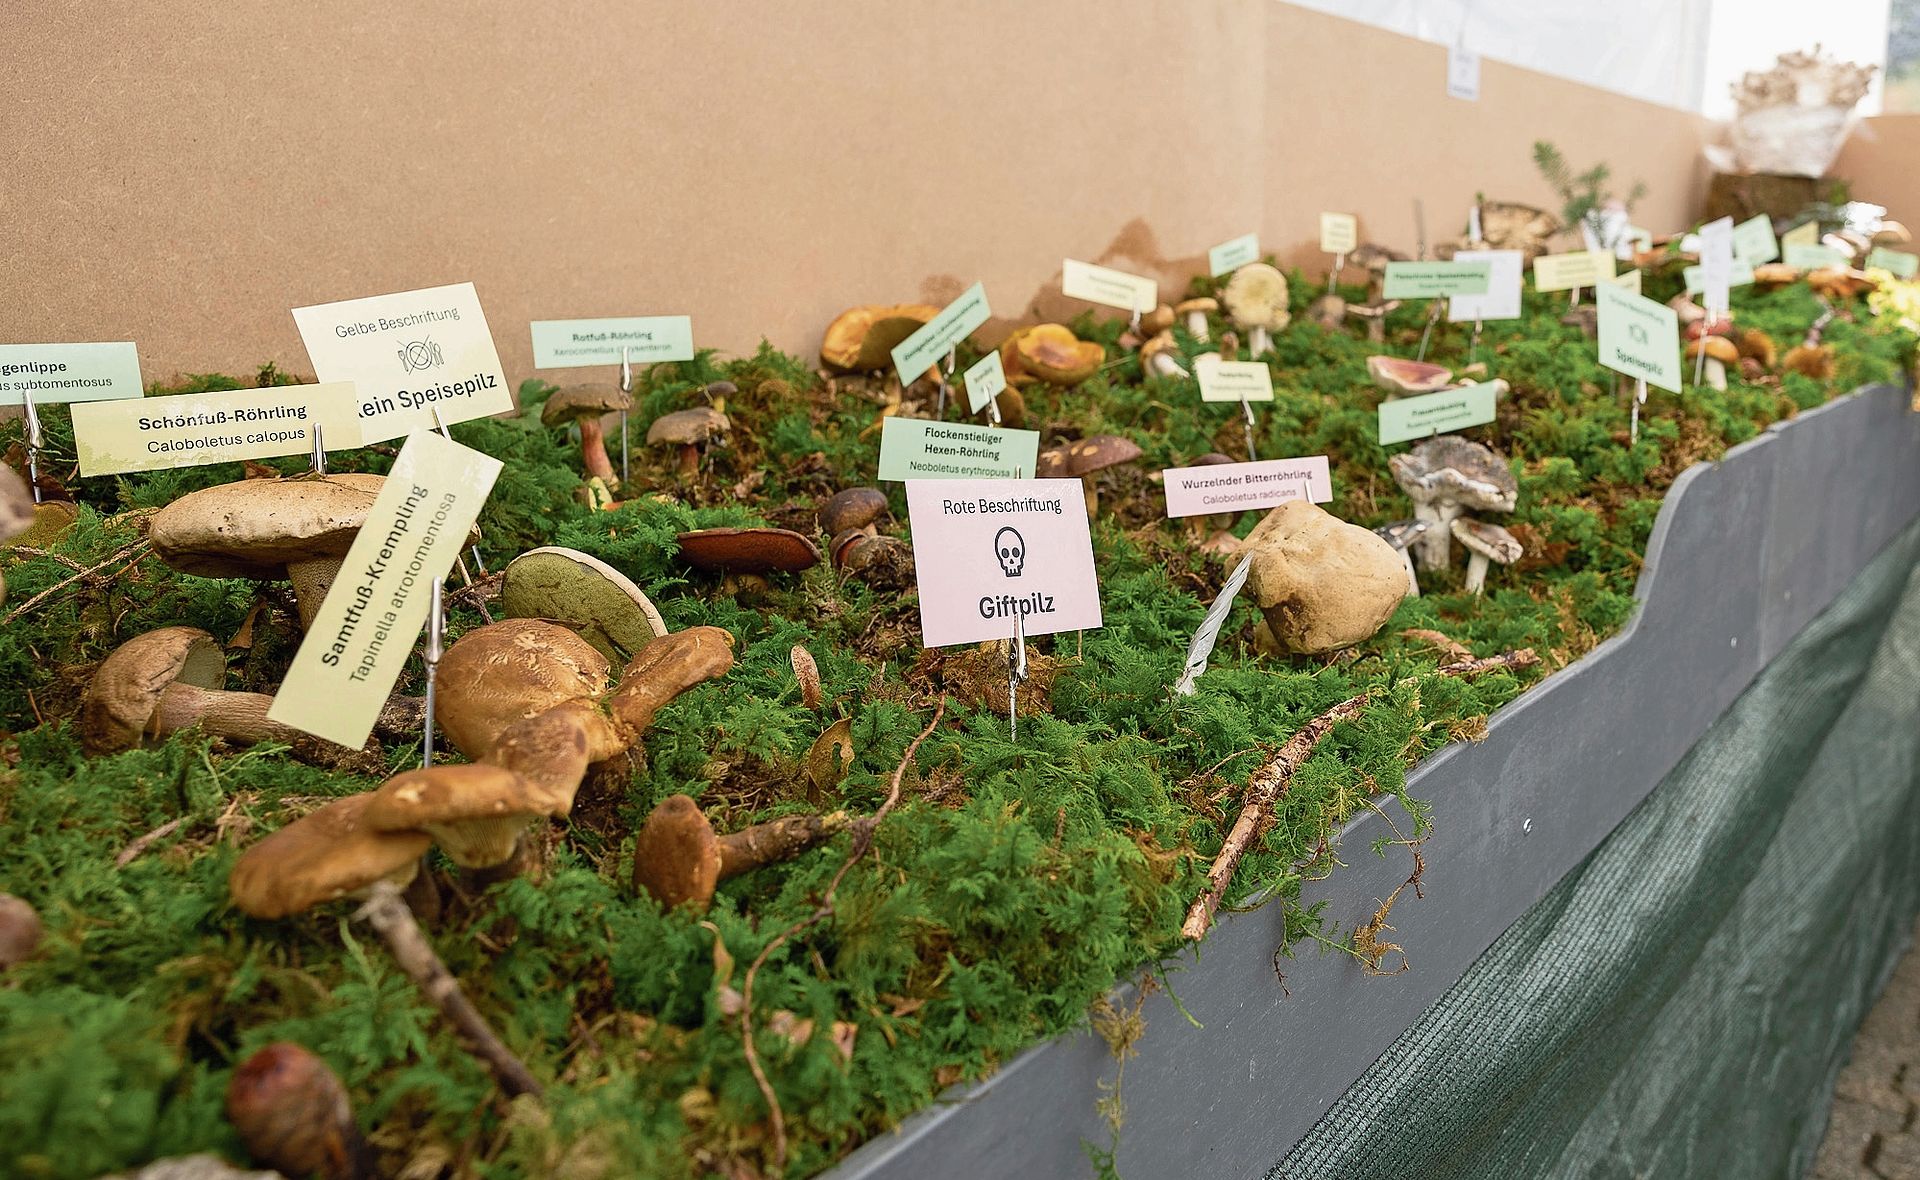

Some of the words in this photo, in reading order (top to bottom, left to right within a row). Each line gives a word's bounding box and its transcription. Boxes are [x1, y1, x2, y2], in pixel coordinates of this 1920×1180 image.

[335, 317, 377, 338] Gelbe
[378, 307, 461, 333] Beschriftung
[0, 361, 67, 377] genlippe
[13, 378, 113, 391] subtomentosus
[356, 395, 395, 418] ein
[398, 373, 498, 410] Speisepilz
[138, 403, 307, 431] Schönfuß-Röhrling
[147, 433, 242, 454] Caloboletus
[246, 427, 306, 447] calopus
[925, 427, 1003, 444] Flockenstieliger
[924, 444, 1000, 461] Hexen-Röhrling
[910, 461, 960, 474] Neoboletus
[961, 465, 1011, 477] erythropusa
[1182, 476, 1243, 490] Wurzelnder
[1245, 470, 1313, 484] Bitterröhrling
[943, 499, 976, 515] Rote
[979, 497, 1062, 514] Beschriftung
[1203, 492, 1258, 505] Caloboletus
[1259, 488, 1297, 500] radicans
[322, 483, 429, 667] Samtfuß-Krempling
[349, 611, 397, 683] Tapinella
[391, 491, 457, 610] atrotomentosa
[979, 592, 1056, 621] Giftpilz
